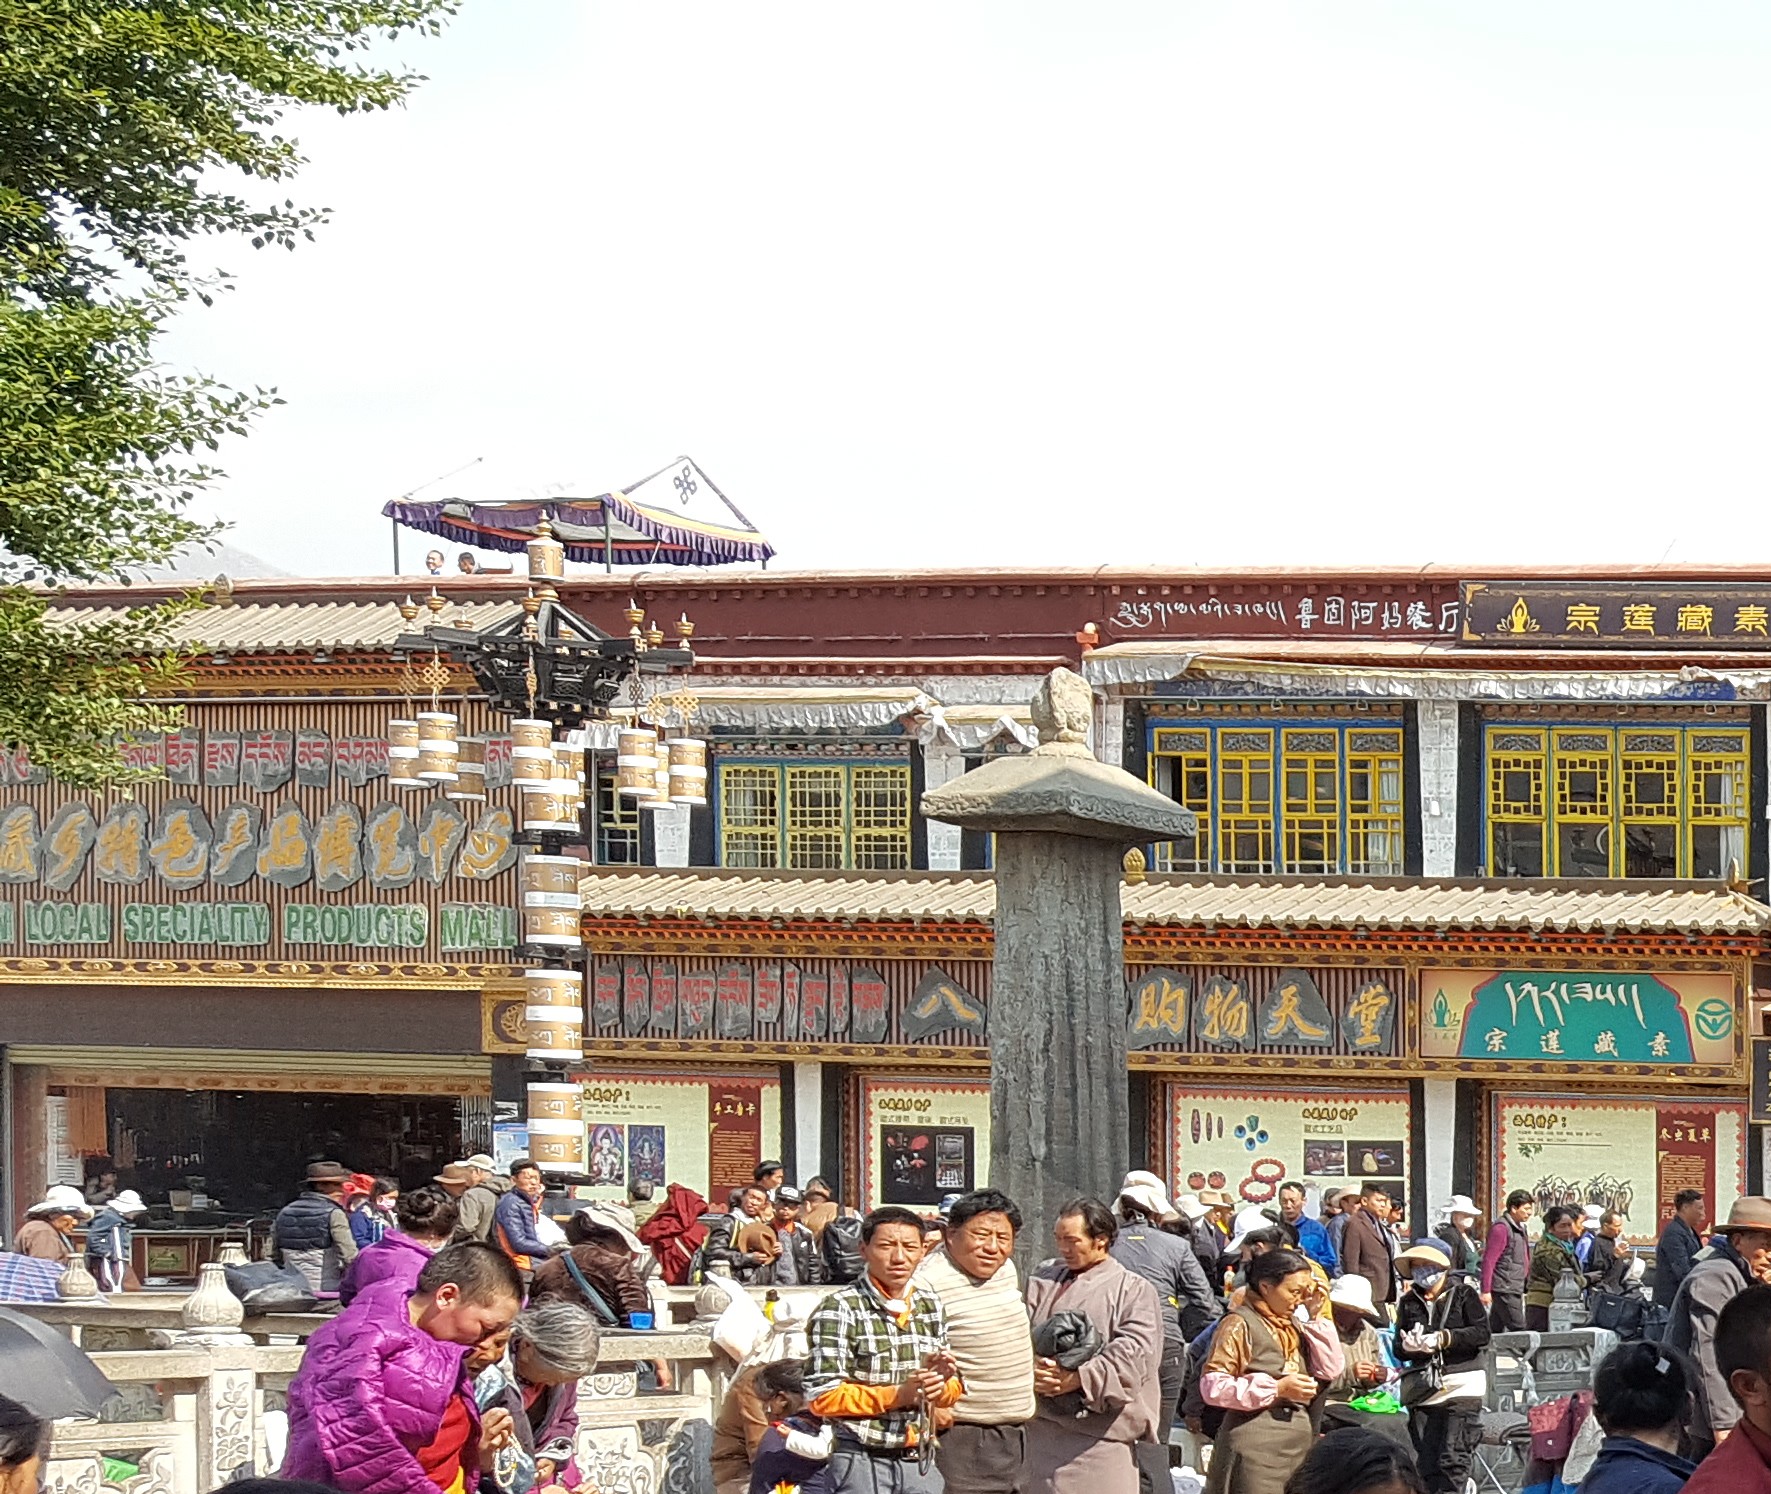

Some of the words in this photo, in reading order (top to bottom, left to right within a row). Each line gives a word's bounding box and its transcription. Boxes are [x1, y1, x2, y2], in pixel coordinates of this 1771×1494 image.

[1295, 597, 1460, 631] 鲁固阿妈餐厅
[25, 903, 108, 941] LOCAL
[125, 904, 269, 945] SPECIALITY
[285, 904, 426, 947] PRODUCTS
[442, 906, 516, 949] MALL
